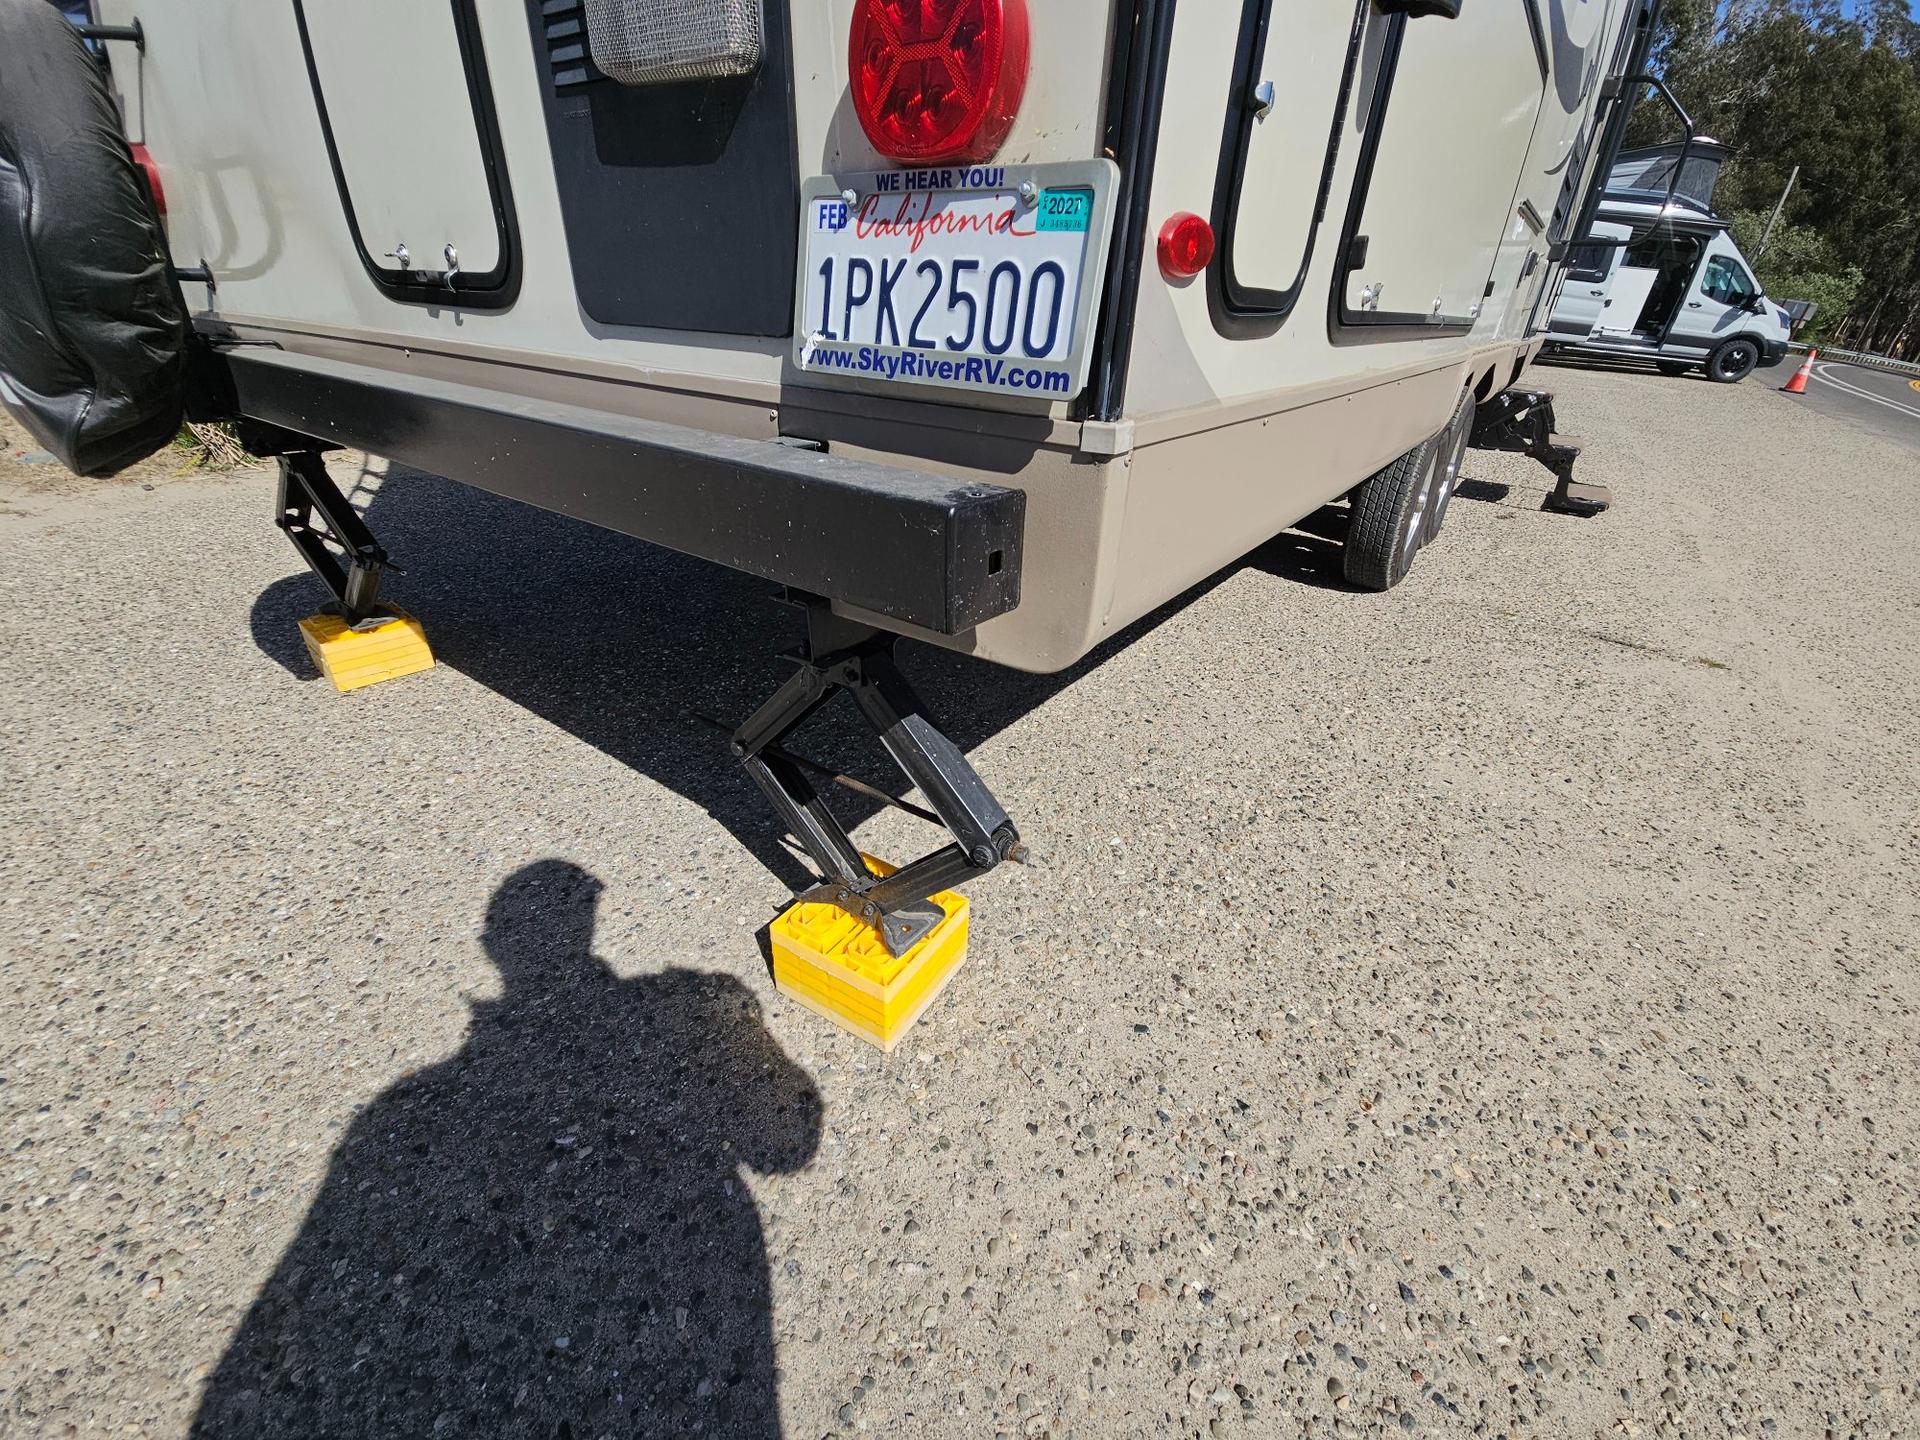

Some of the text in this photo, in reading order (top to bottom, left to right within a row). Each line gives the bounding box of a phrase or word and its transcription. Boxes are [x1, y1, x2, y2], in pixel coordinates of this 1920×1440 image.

[876, 168, 1004, 191] WE HEAR YOU!
[819, 203, 848, 229] FEB
[1048, 197, 1083, 215] 2027
[856, 191, 1037, 254] California
[818, 256, 1066, 358] 1PK2500
